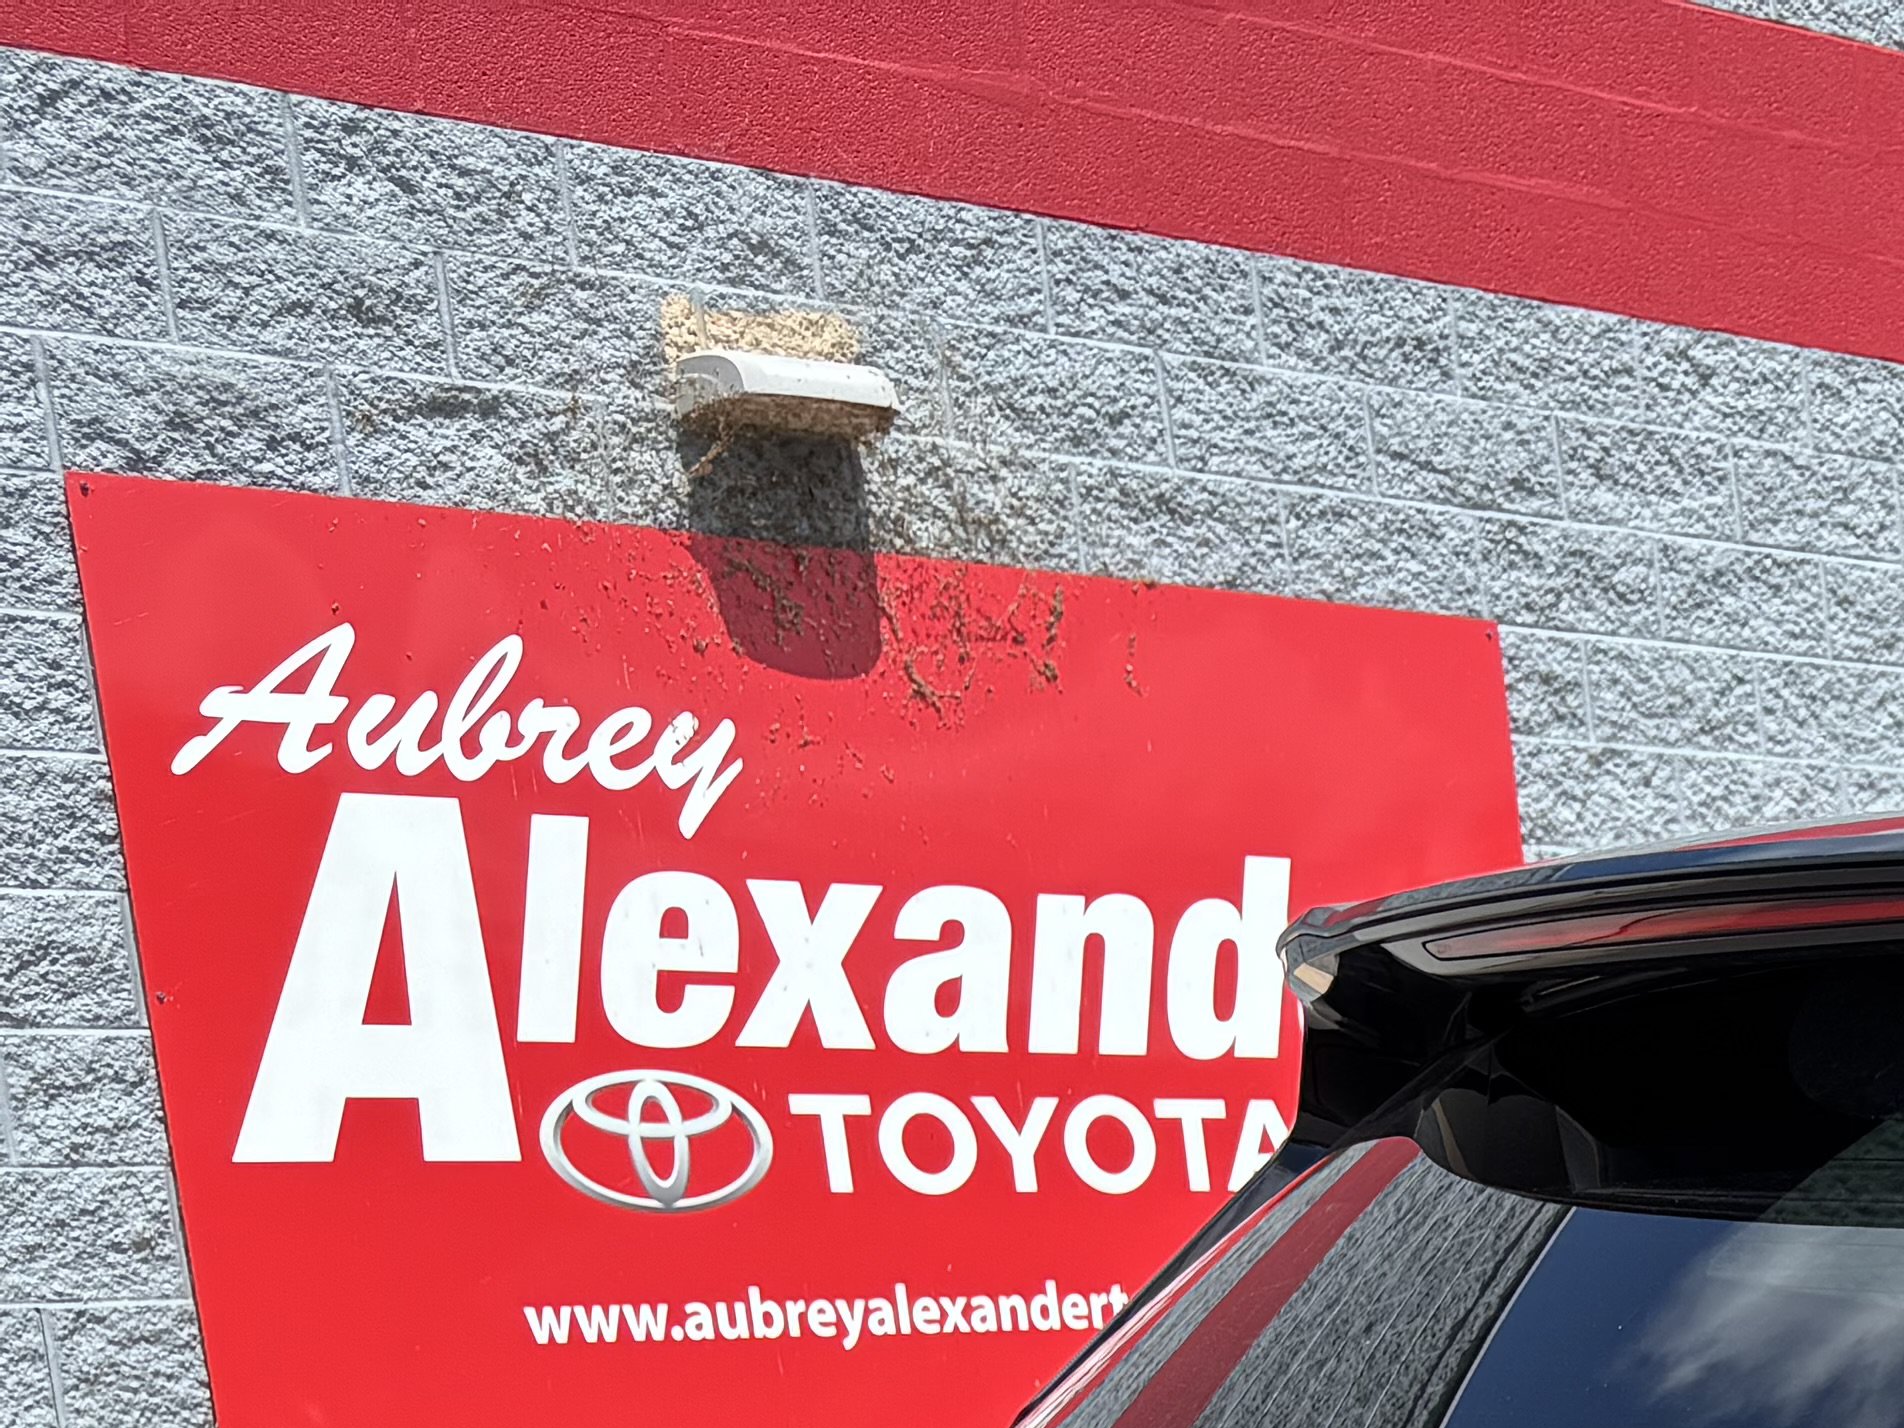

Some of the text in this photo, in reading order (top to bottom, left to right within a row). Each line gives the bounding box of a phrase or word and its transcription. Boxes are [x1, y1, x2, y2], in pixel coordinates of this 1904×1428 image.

[171, 622, 743, 839] Aubrey
[232, 792, 1305, 1163] Alexand
[788, 1091, 1294, 1196] TOYOTA
[523, 1279, 1129, 1351] www.aubreyalexandert
